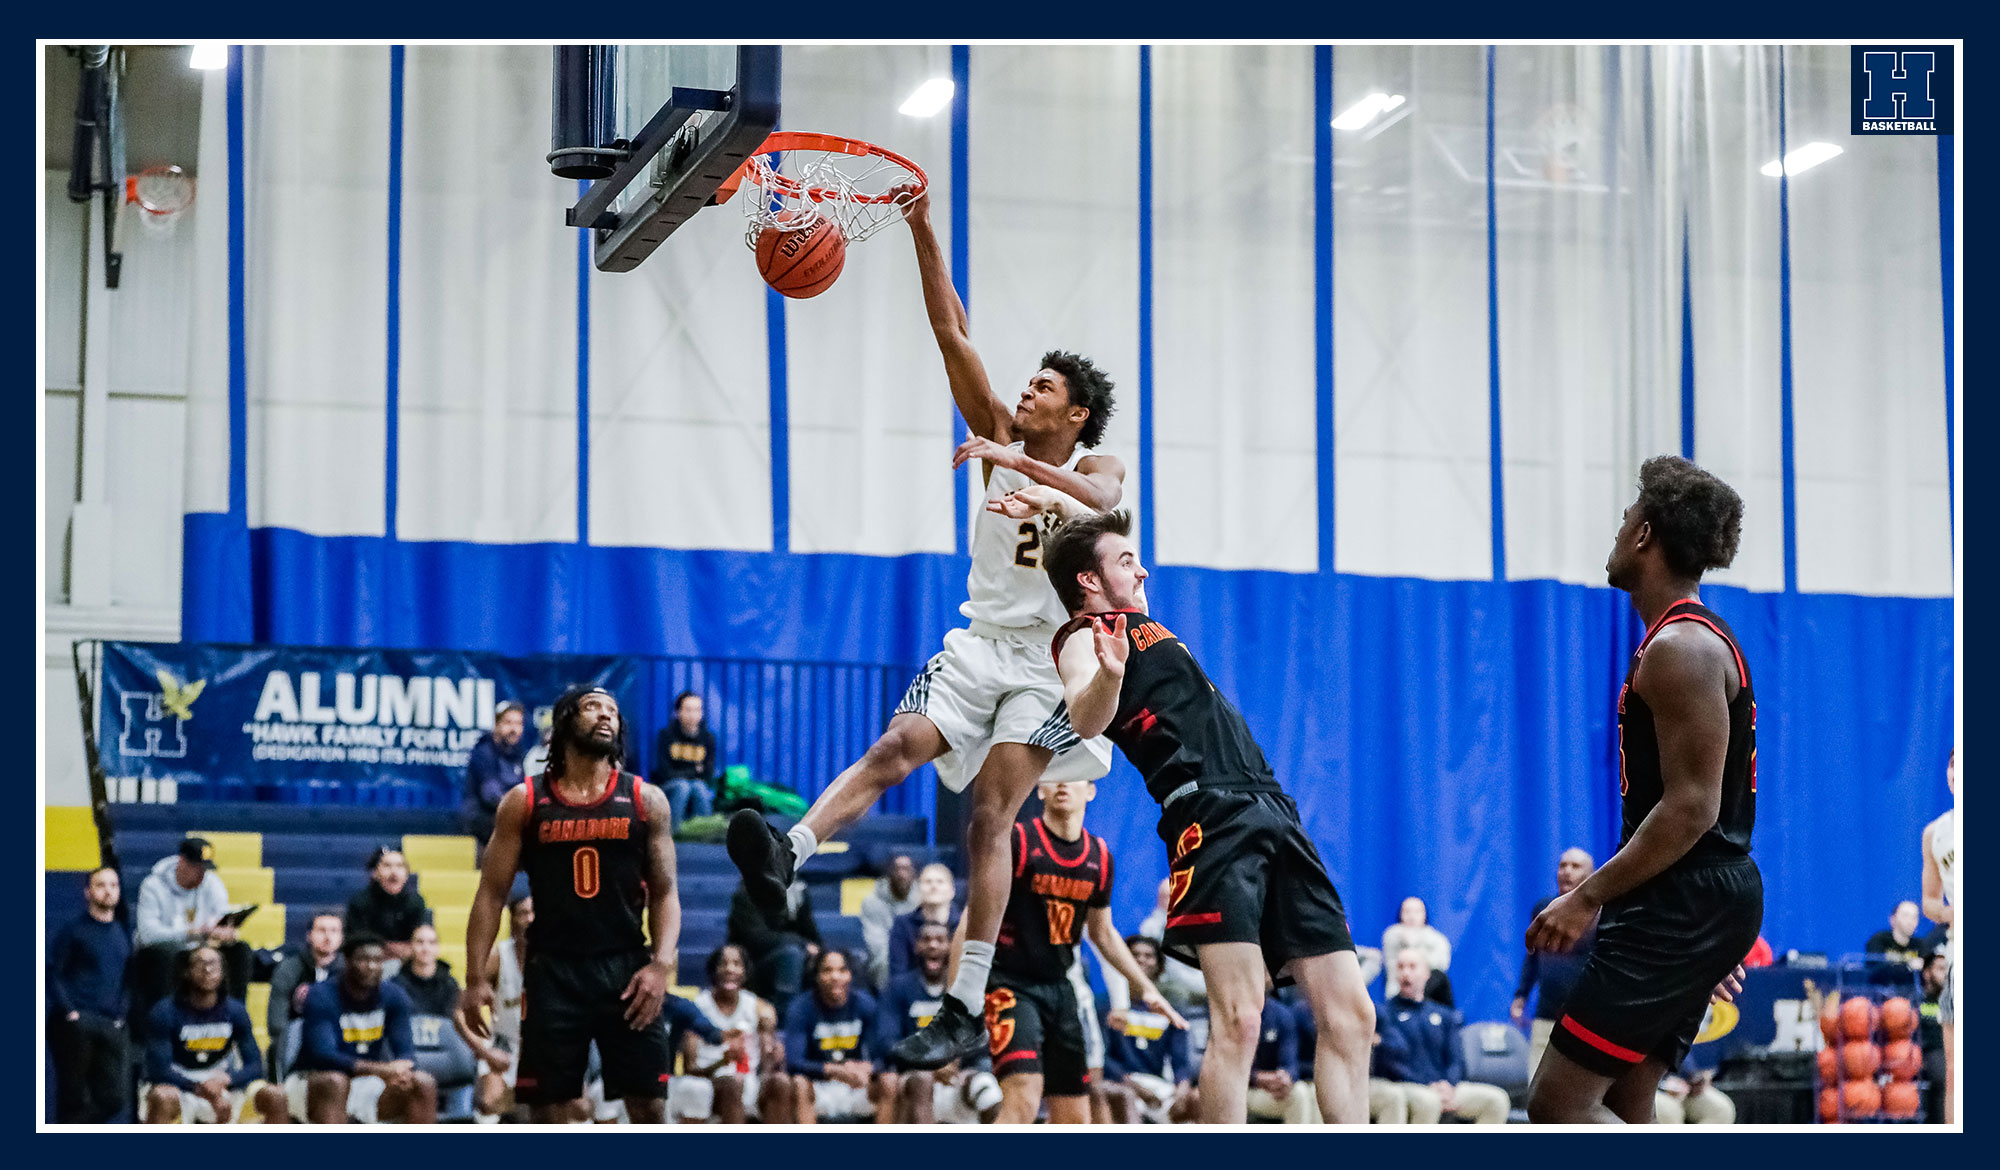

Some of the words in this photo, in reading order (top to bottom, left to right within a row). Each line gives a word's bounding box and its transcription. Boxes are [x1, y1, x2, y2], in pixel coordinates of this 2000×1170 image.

[780, 216, 827, 259] Wilson
[252, 669, 495, 731] ALUMNI
[321, 724, 399, 749] FAMILY
[401, 727, 447, 750] FOR
[539, 816, 631, 843] CANADORE
[573, 846, 600, 899] 0
